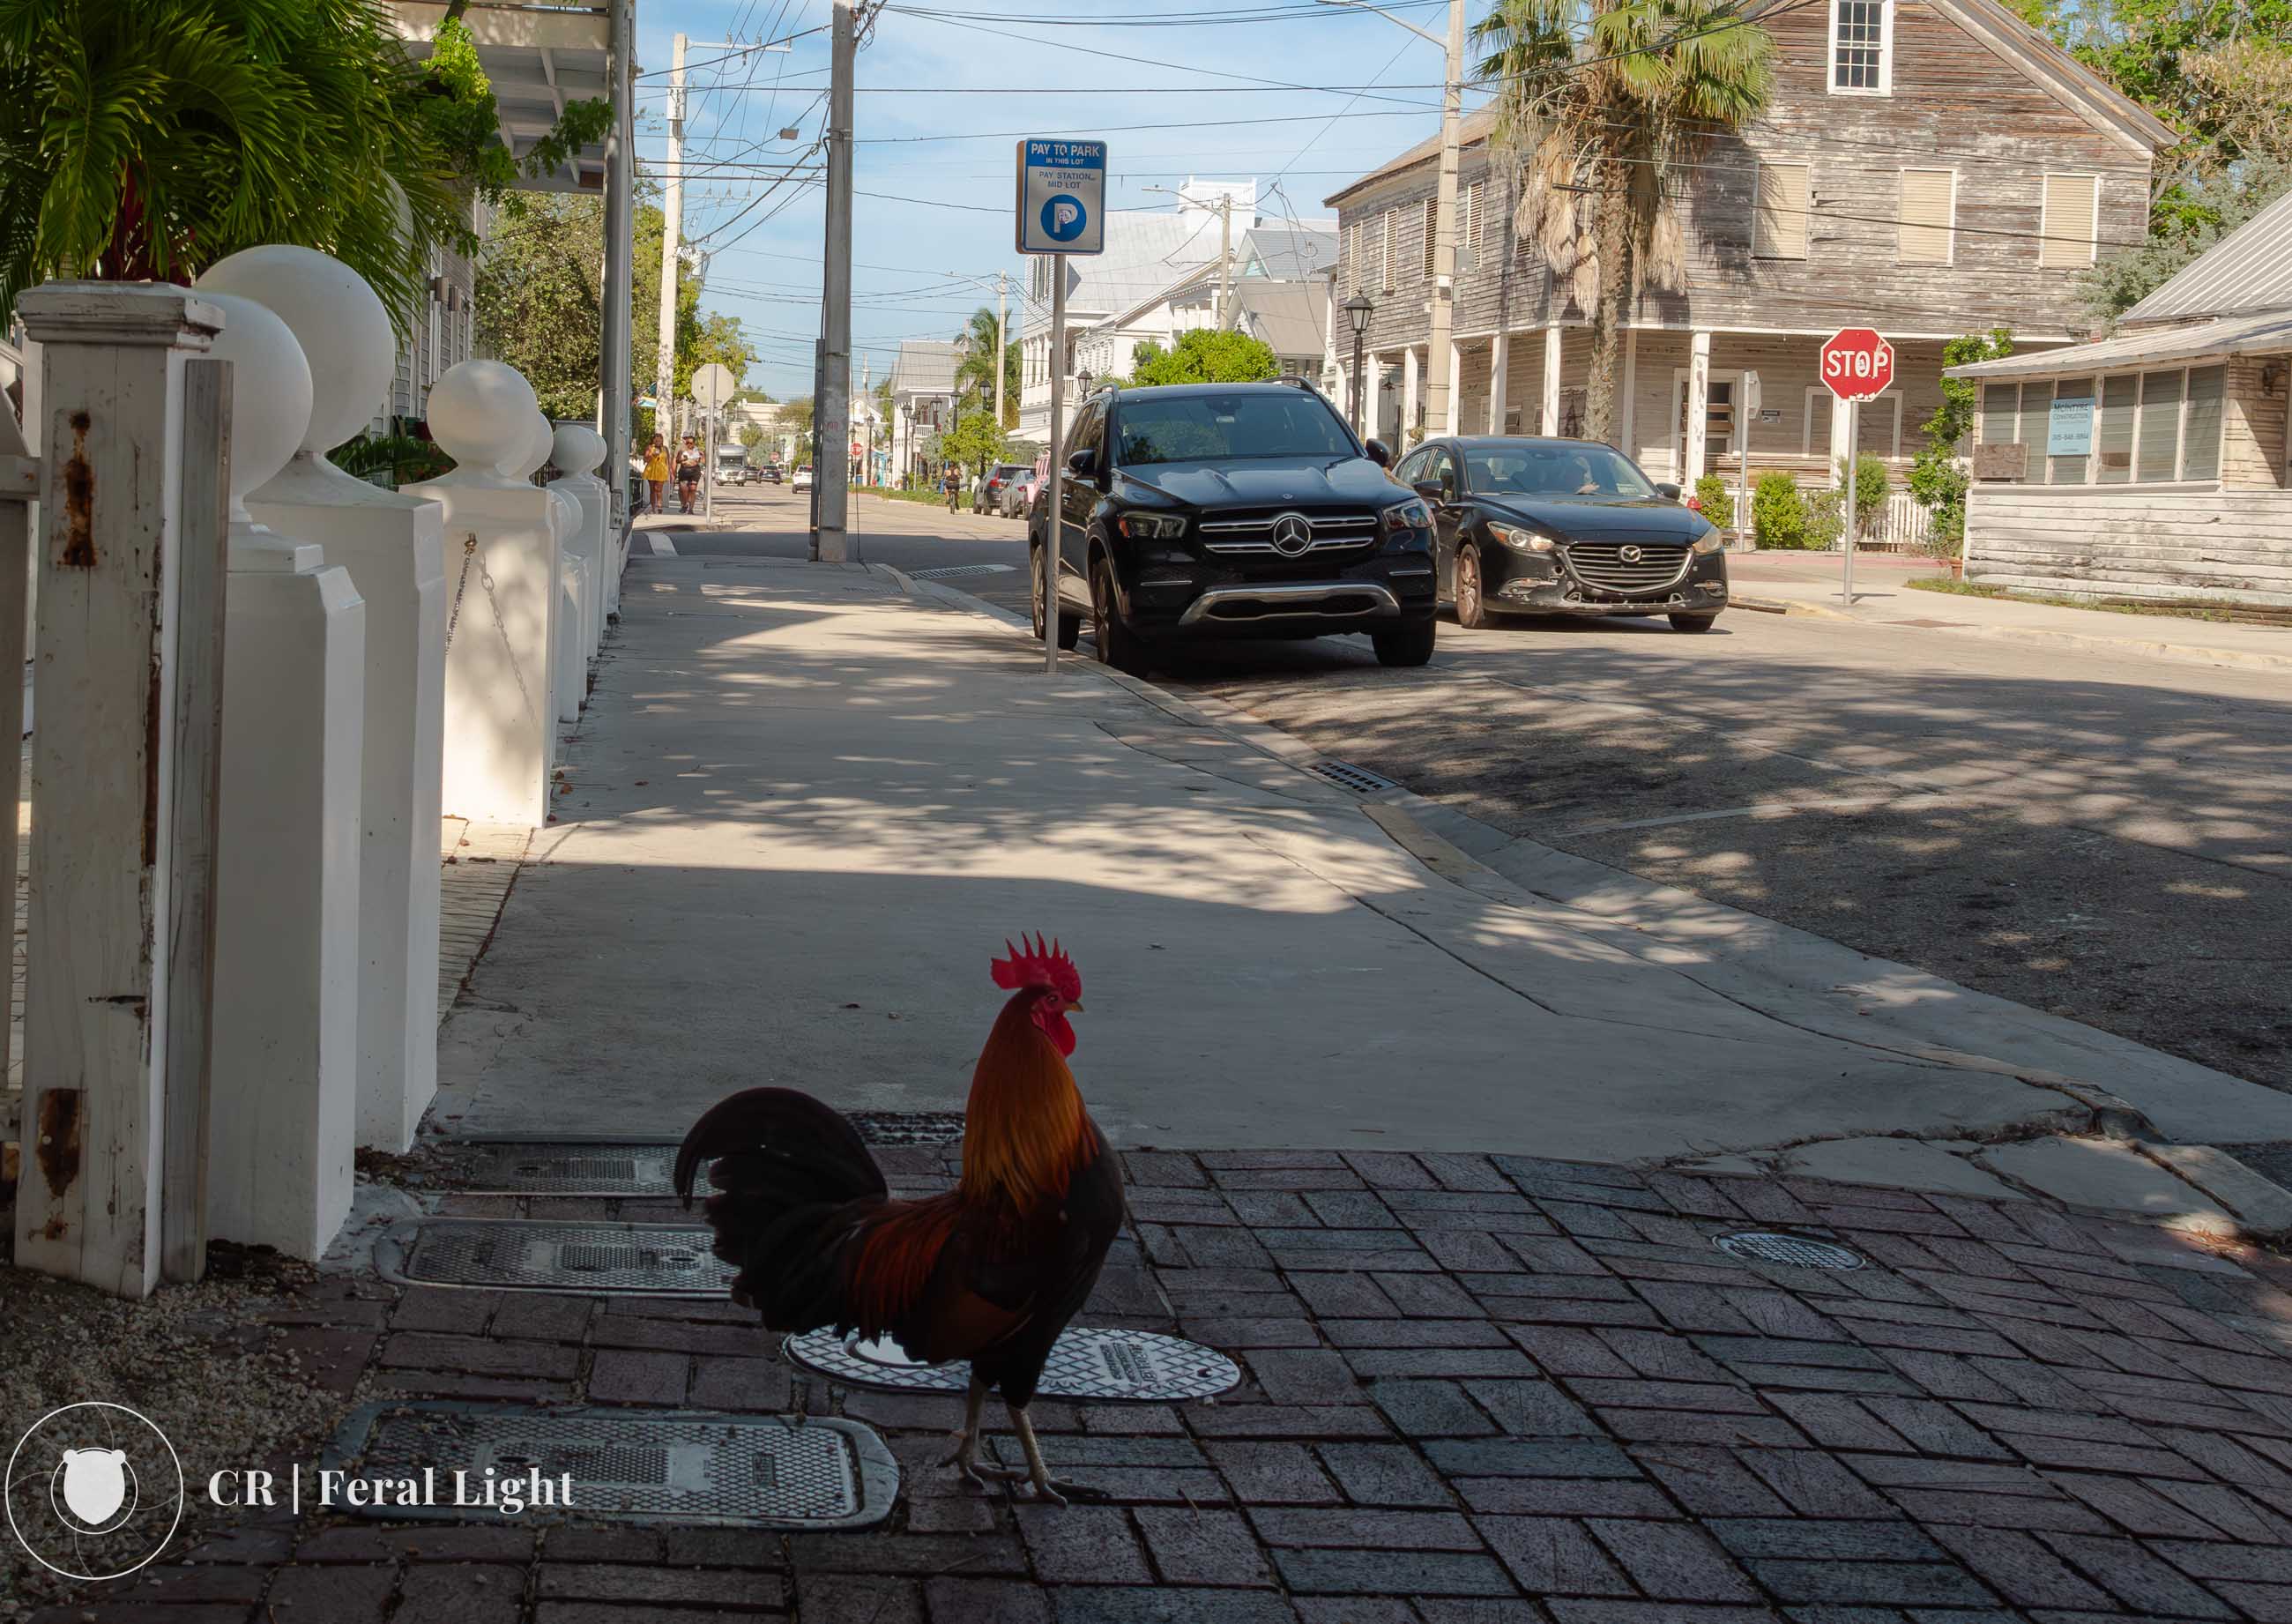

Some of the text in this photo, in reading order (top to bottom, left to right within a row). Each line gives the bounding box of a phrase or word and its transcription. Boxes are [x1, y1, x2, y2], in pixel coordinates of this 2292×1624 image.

[1031, 143, 1100, 157] PAY TO PARK
[1827, 349, 1888, 378] STOP
